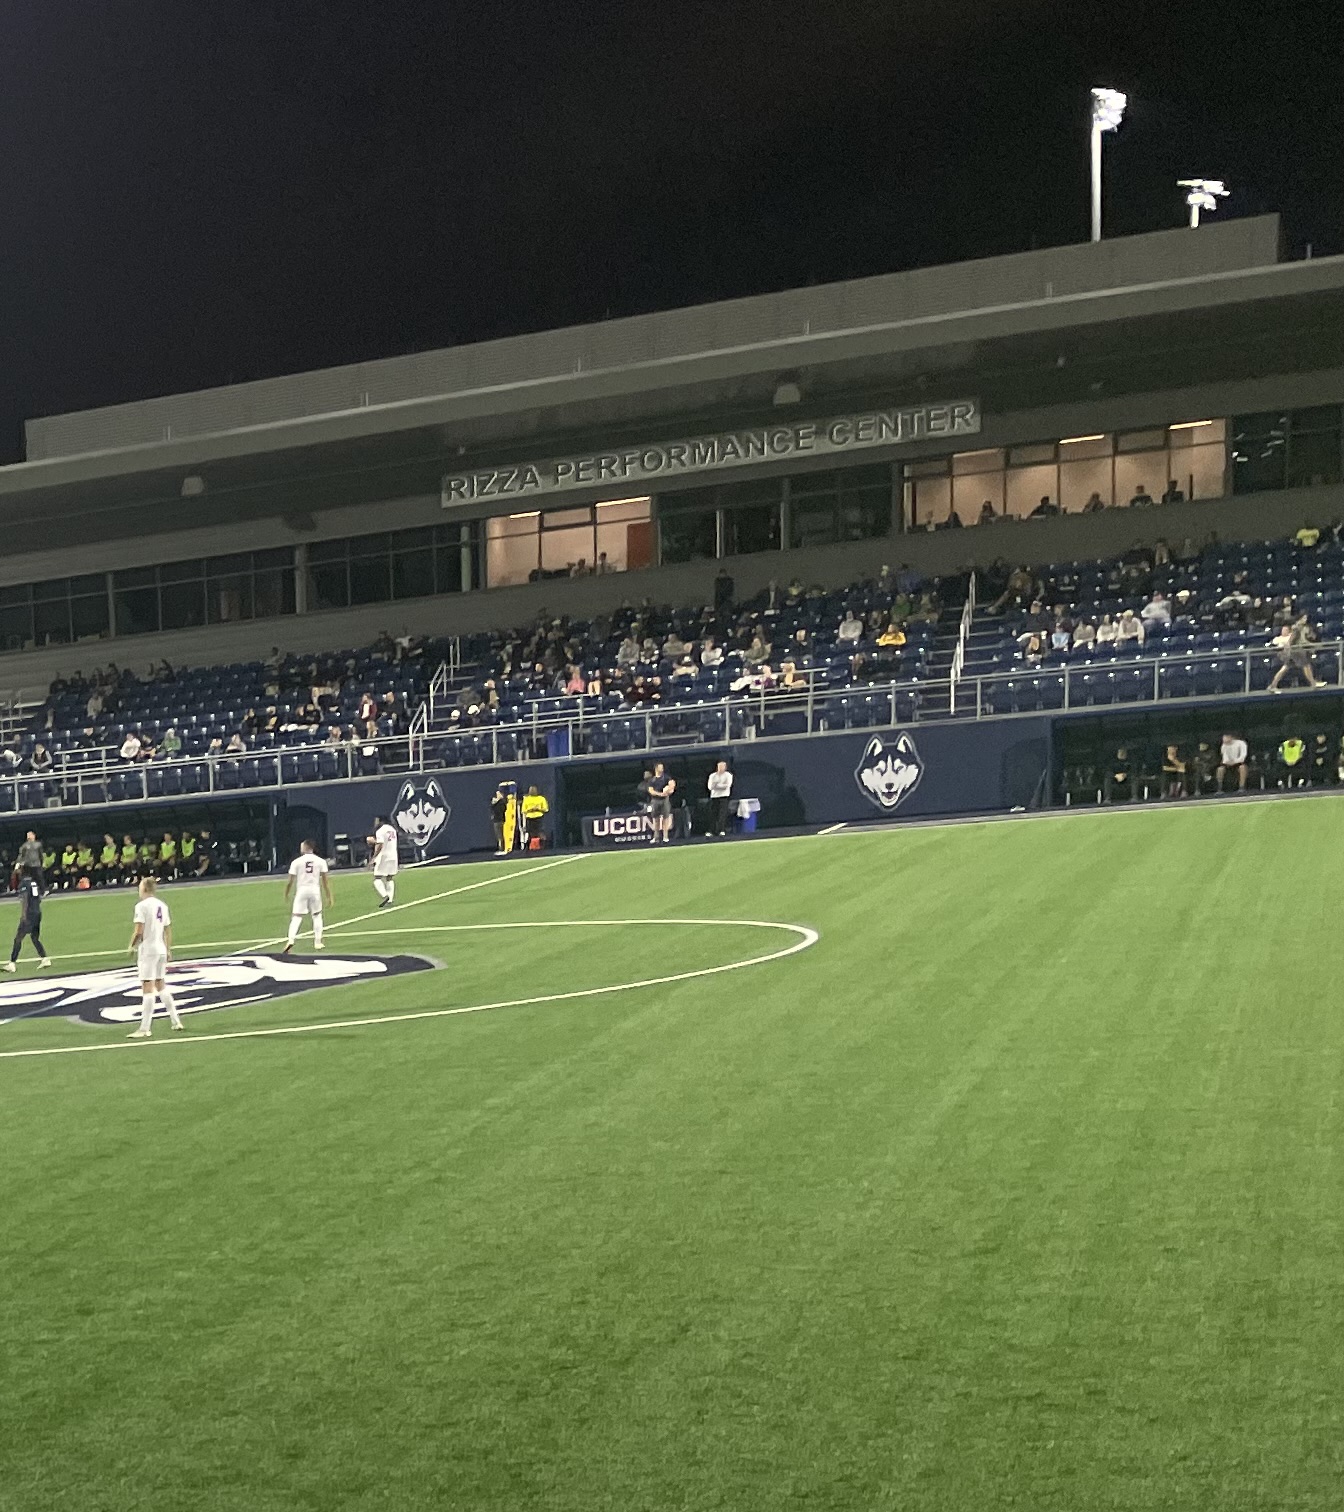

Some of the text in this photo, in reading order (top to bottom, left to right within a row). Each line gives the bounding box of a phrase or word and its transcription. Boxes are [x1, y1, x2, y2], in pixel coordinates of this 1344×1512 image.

[448, 402, 975, 501] RIZZA PERFORMANCE CENTER
[305, 861, 314, 874] 5
[156, 905, 163, 923] 4
